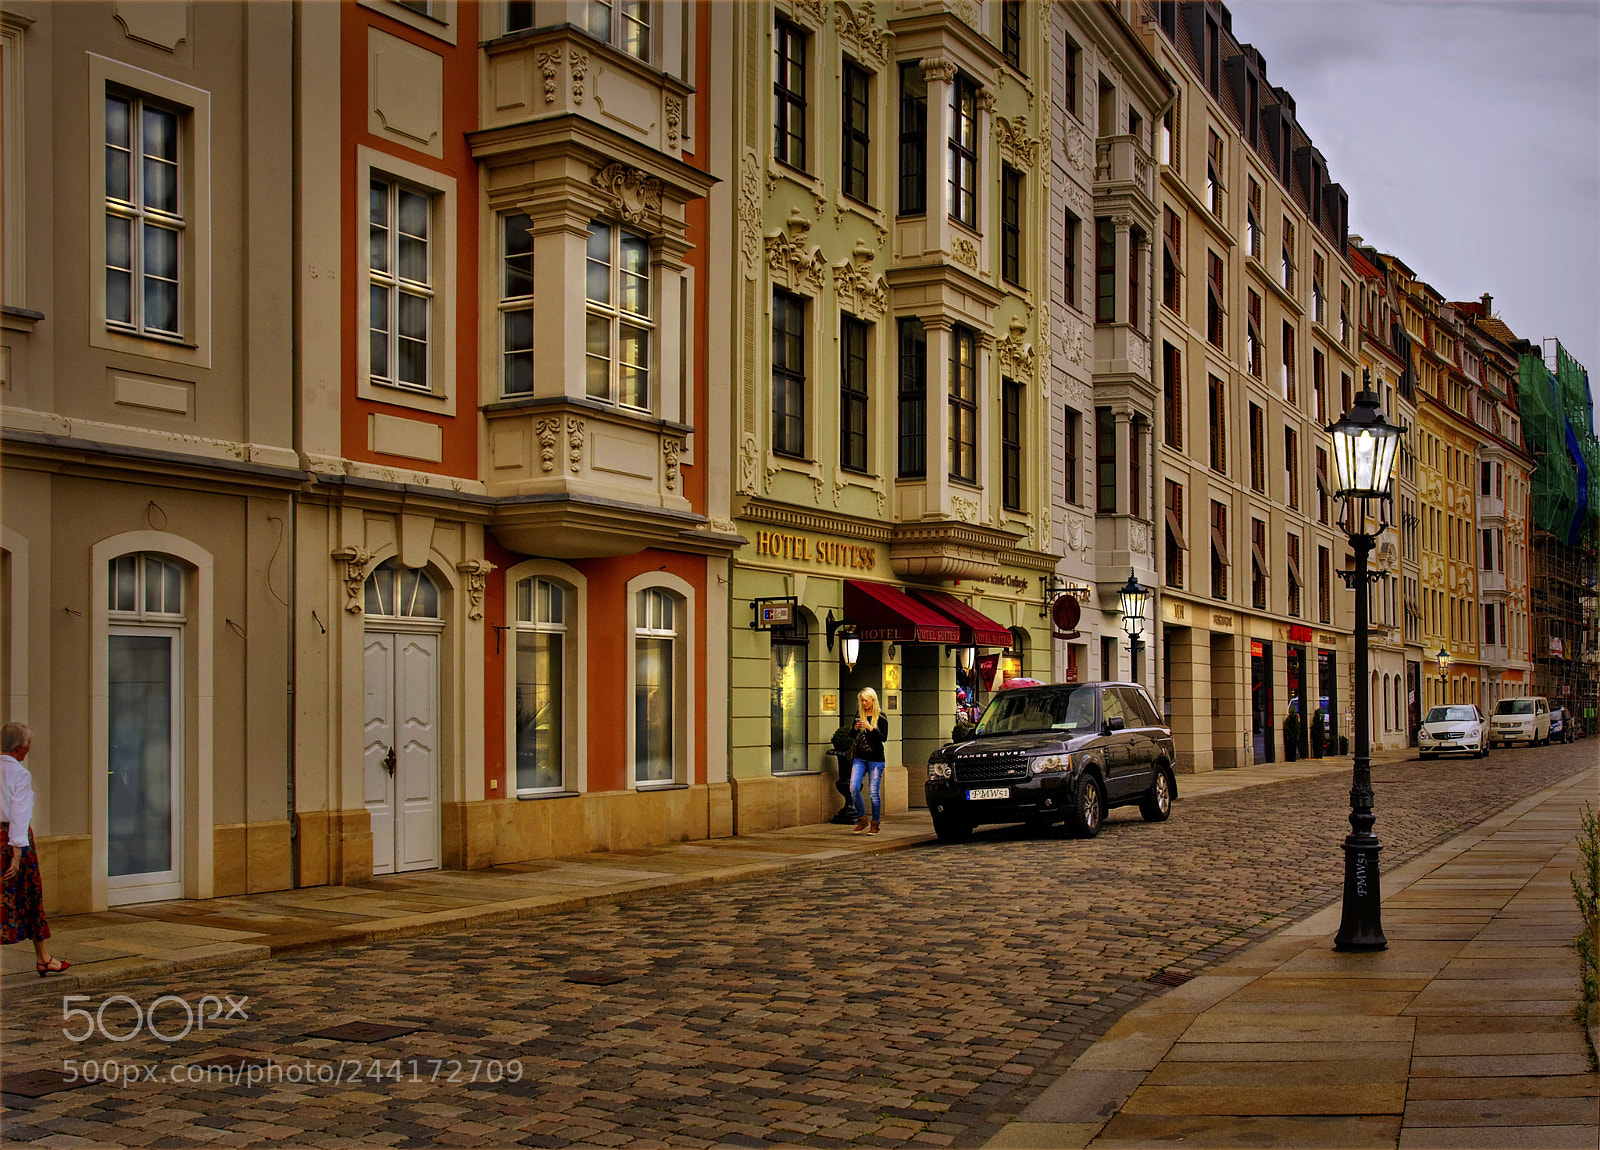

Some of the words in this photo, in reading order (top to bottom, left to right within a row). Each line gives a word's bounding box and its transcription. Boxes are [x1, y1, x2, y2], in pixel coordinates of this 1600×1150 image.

[757, 530, 813, 560] HOTEL
[816, 540, 876, 569] SUITESS
[860, 628, 902, 640] HOTEL
[916, 627, 936, 640] HOTEL
[937, 628, 960, 641] SUITESS
